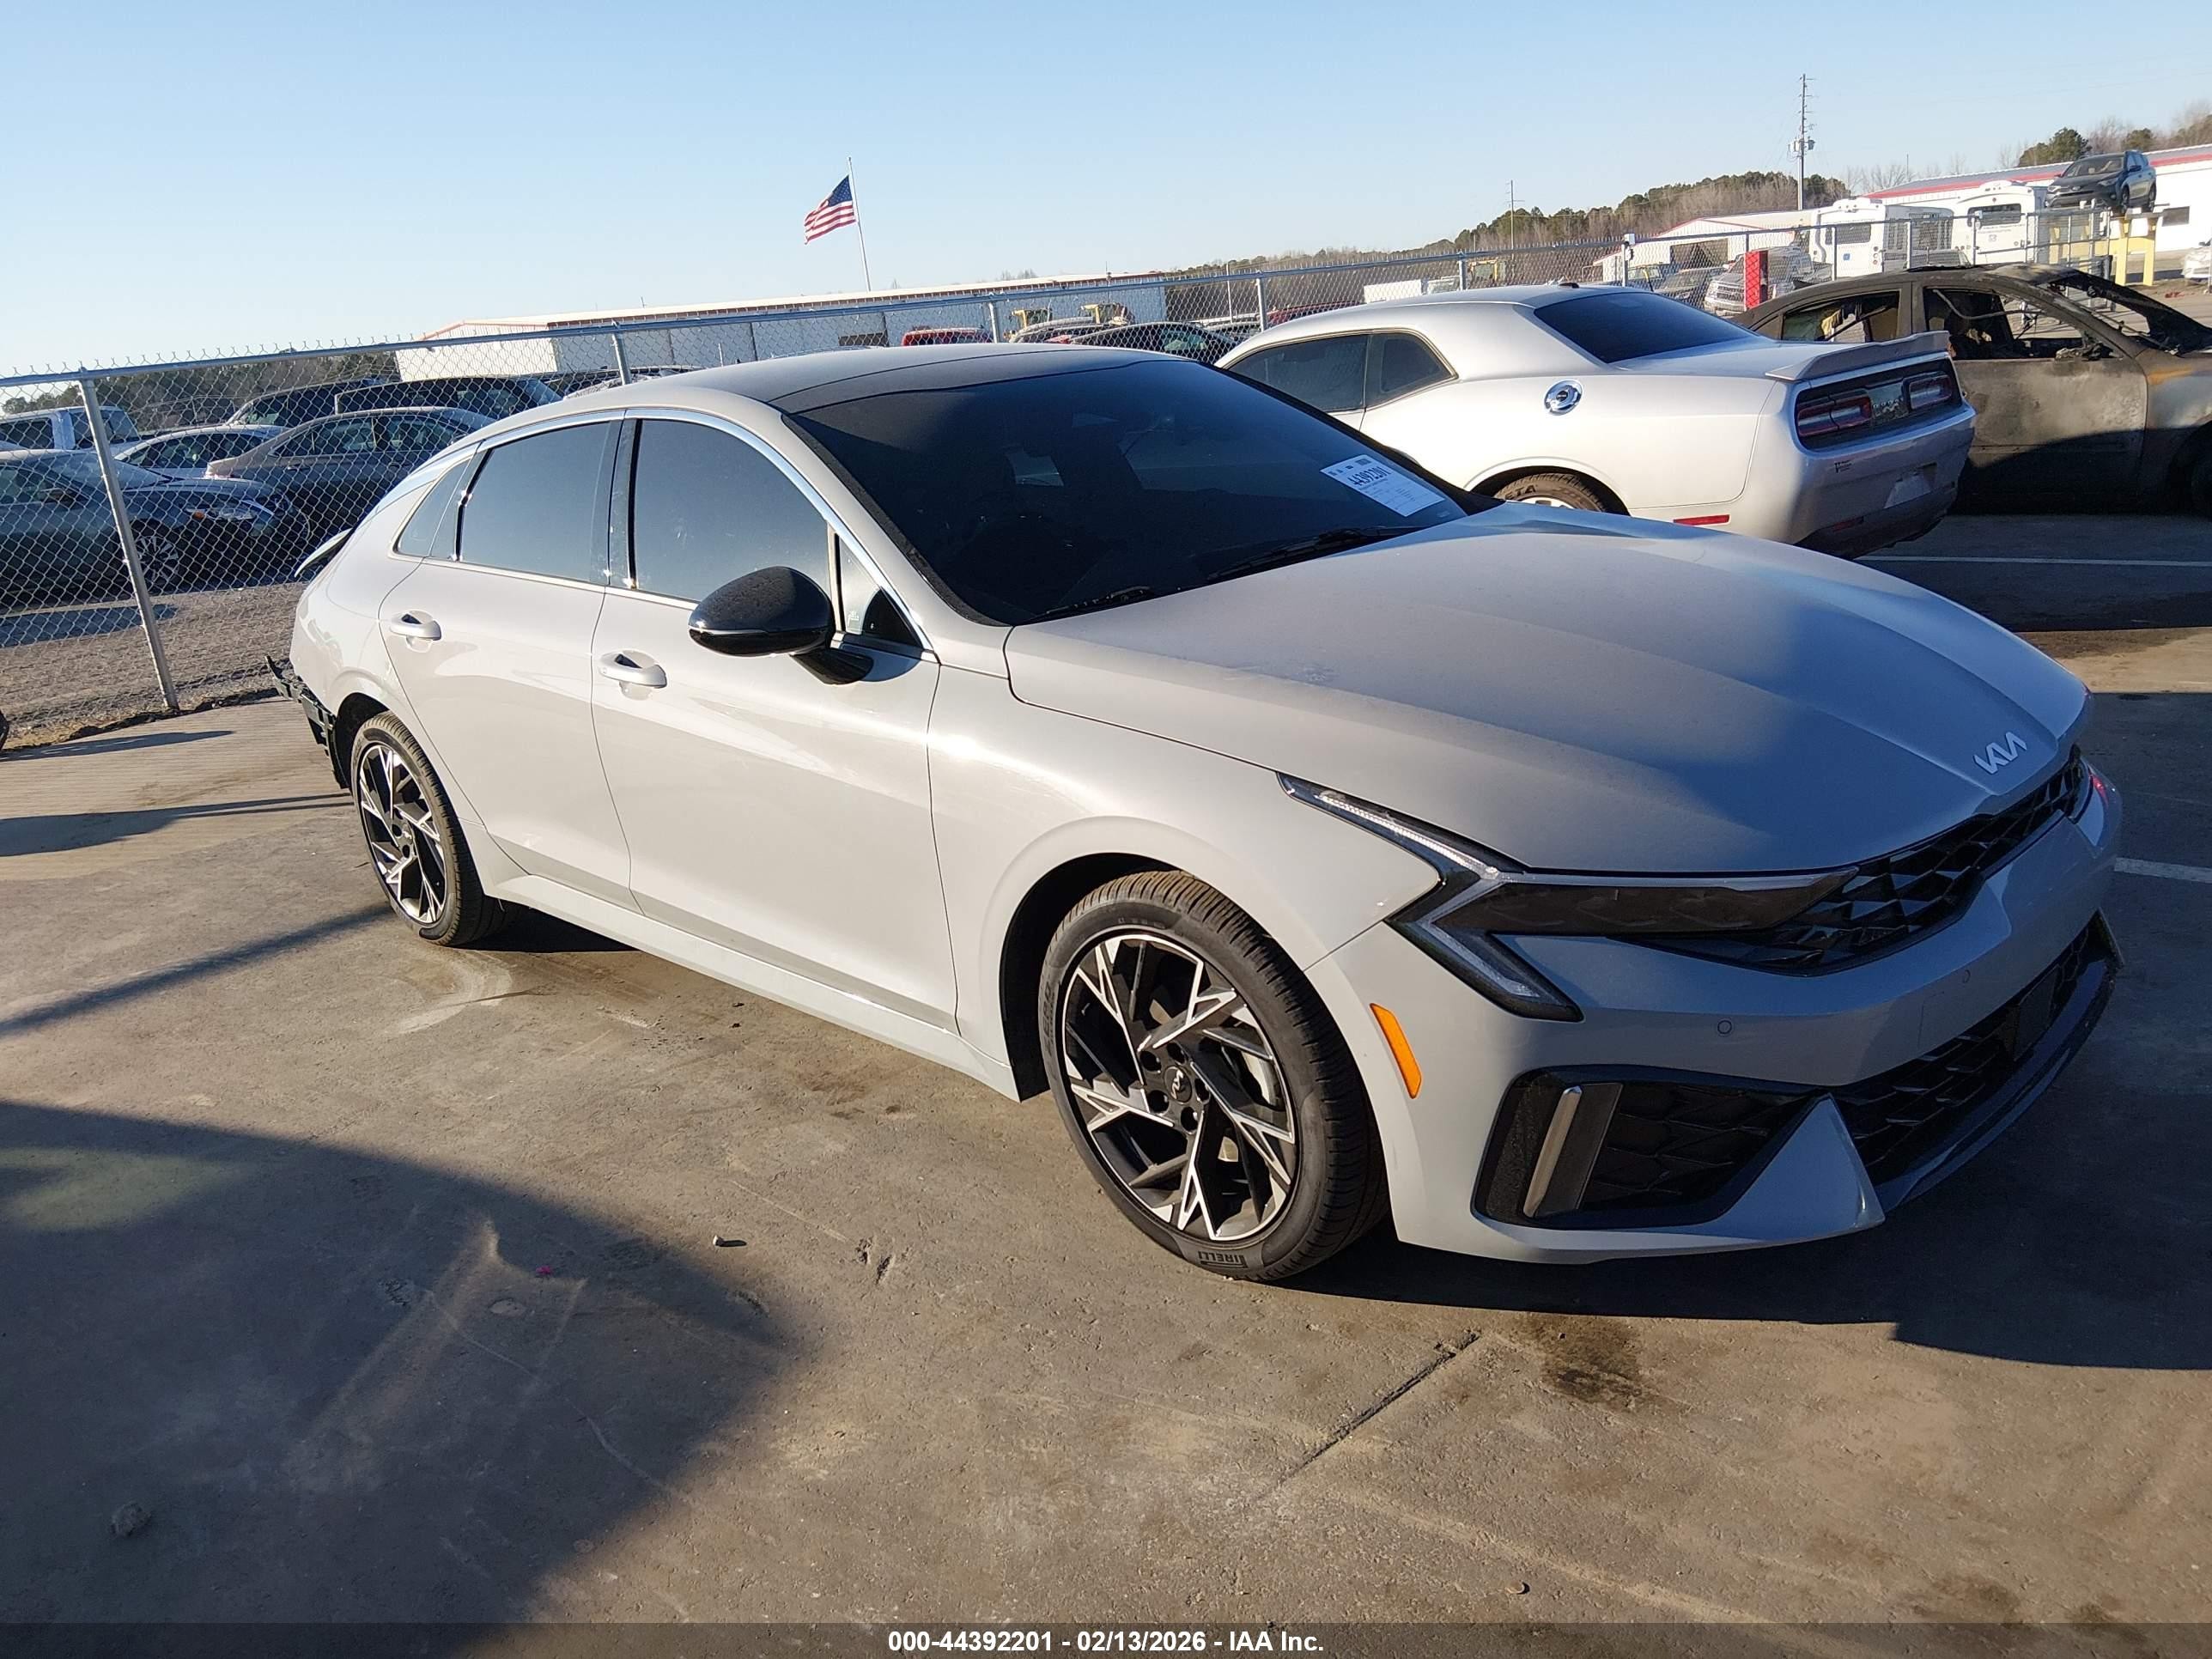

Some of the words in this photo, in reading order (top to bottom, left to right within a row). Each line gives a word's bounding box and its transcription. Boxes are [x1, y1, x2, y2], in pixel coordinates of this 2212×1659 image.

[1347, 465, 1392, 486] 44392201
[1973, 731, 2028, 775] KIA
[1197, 1250, 1249, 1268] PIRELLI
